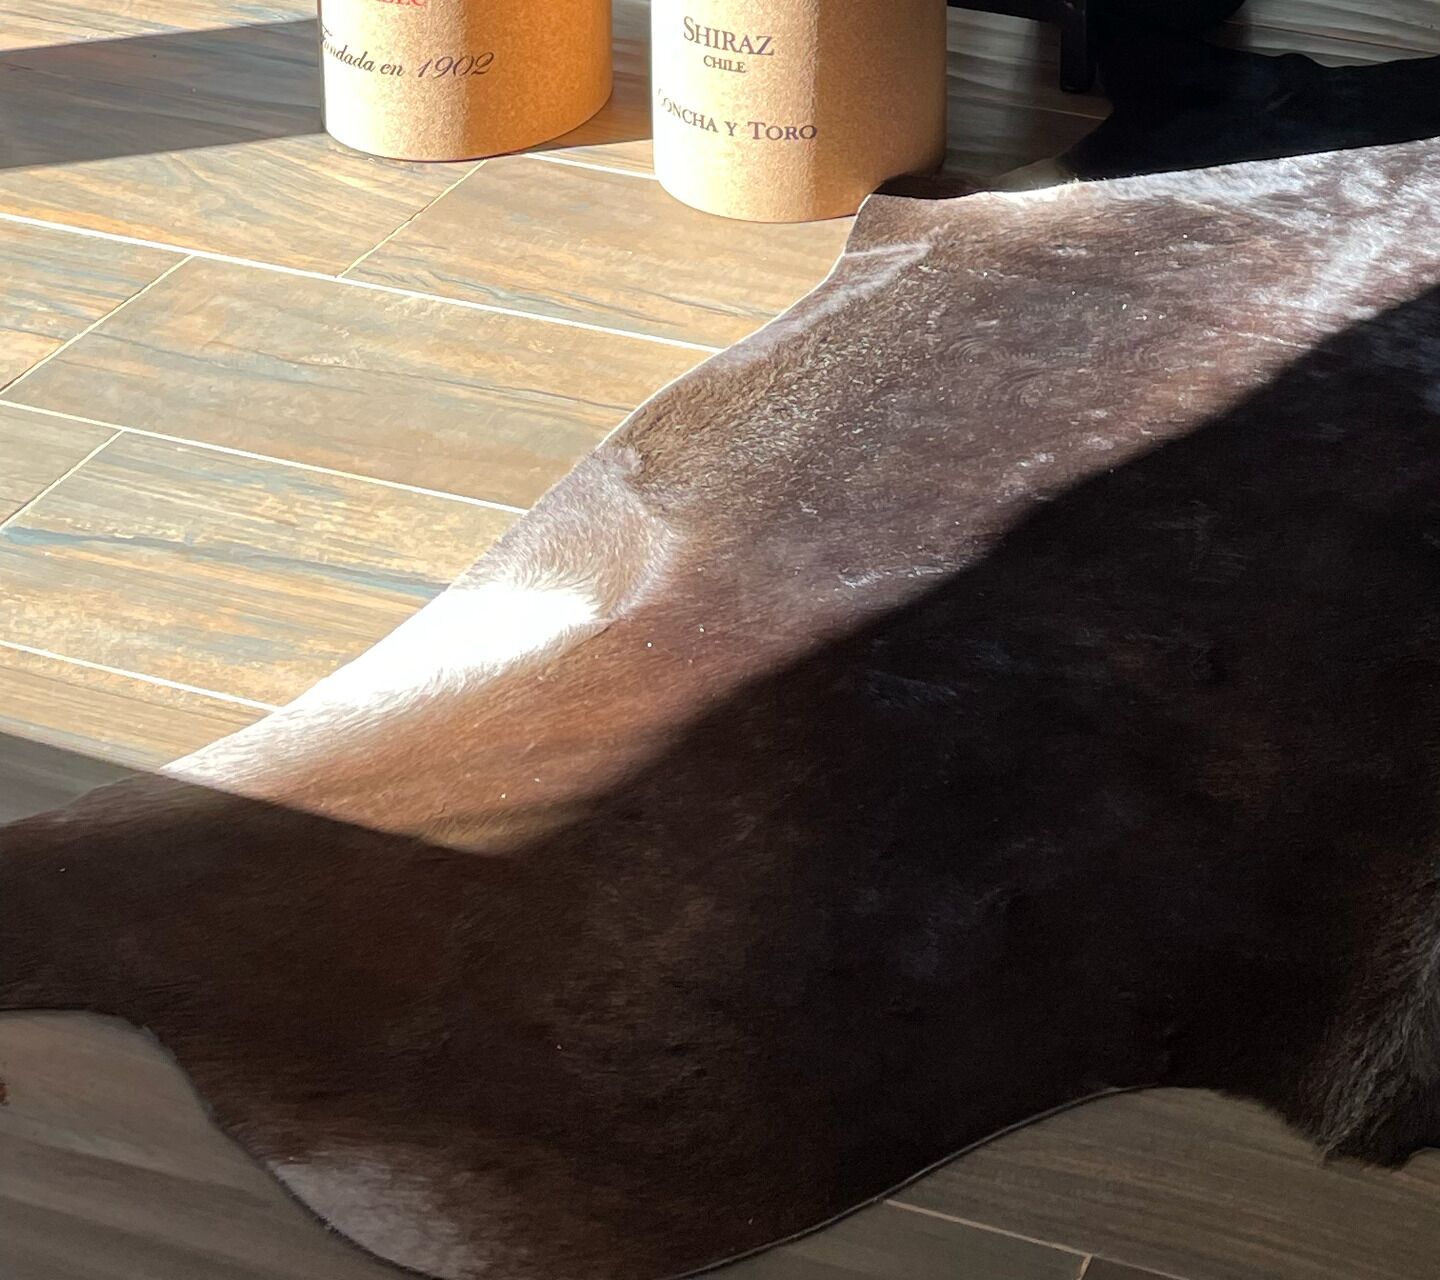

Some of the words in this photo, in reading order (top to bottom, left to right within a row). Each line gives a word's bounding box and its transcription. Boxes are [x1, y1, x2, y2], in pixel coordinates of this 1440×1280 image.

[683, 16, 775, 56] SHIRAZ
[379, 62, 406, 77] en
[417, 51, 496, 78] 1902
[703, 55, 746, 73] CHILE
[657, 88, 719, 134] ONCHA
[724, 120, 739, 137] Y
[747, 121, 818, 140] TORO
